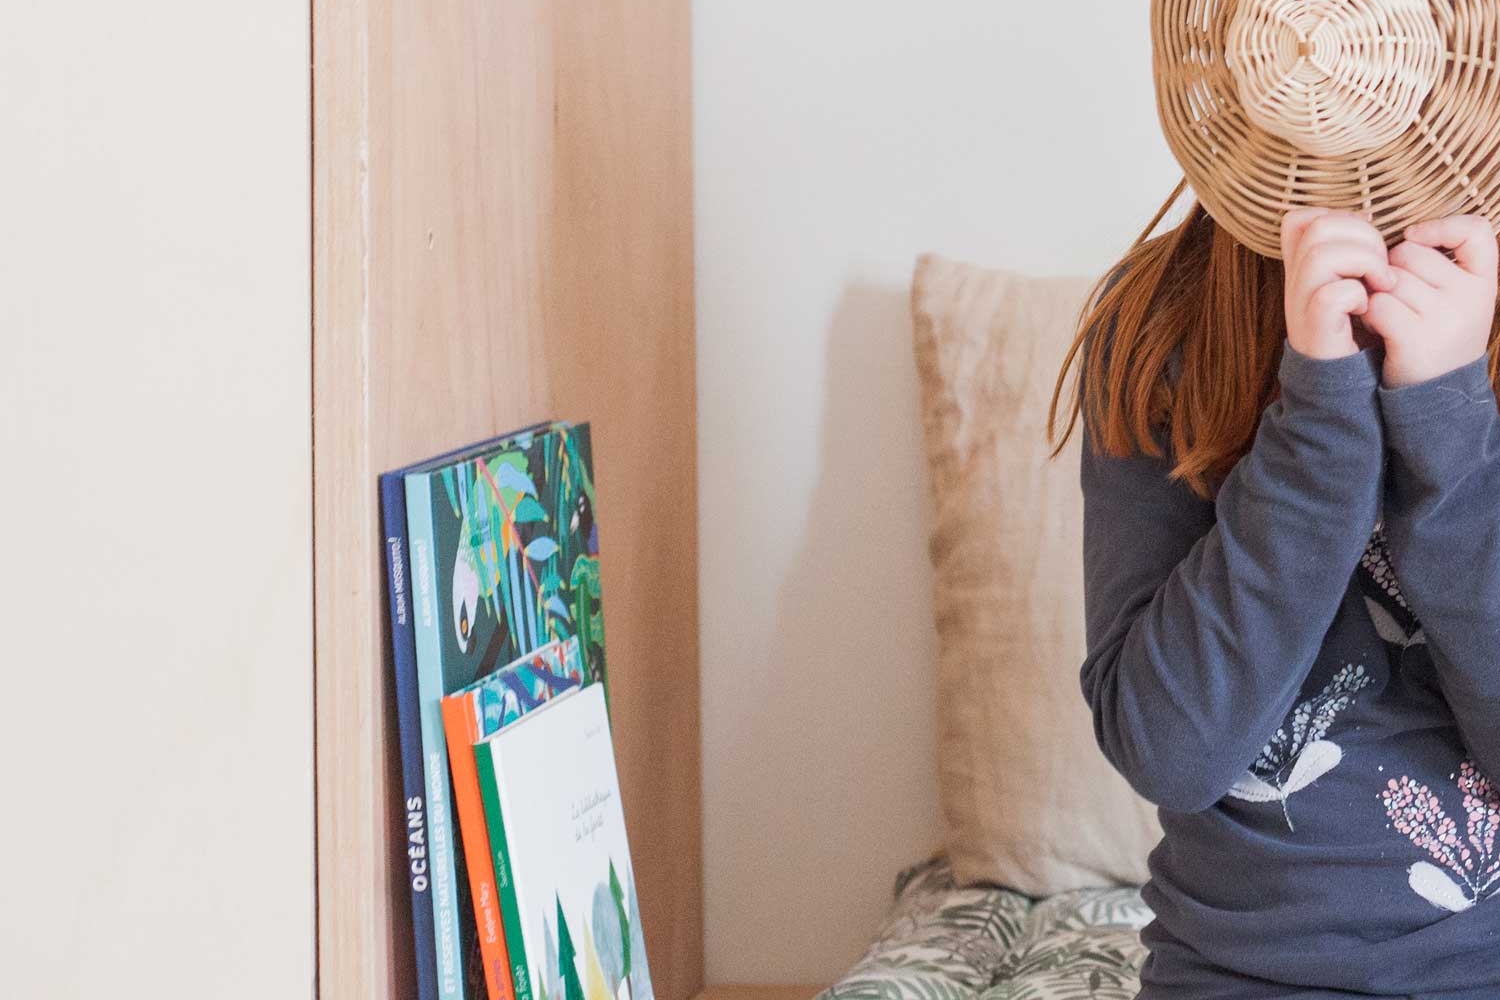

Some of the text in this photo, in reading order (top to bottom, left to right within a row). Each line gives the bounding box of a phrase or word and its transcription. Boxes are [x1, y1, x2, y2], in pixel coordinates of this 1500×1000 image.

[429, 751, 443, 802] MONDE
[432, 803, 445, 824] DU
[406, 796, 428, 892] OCÉANS
